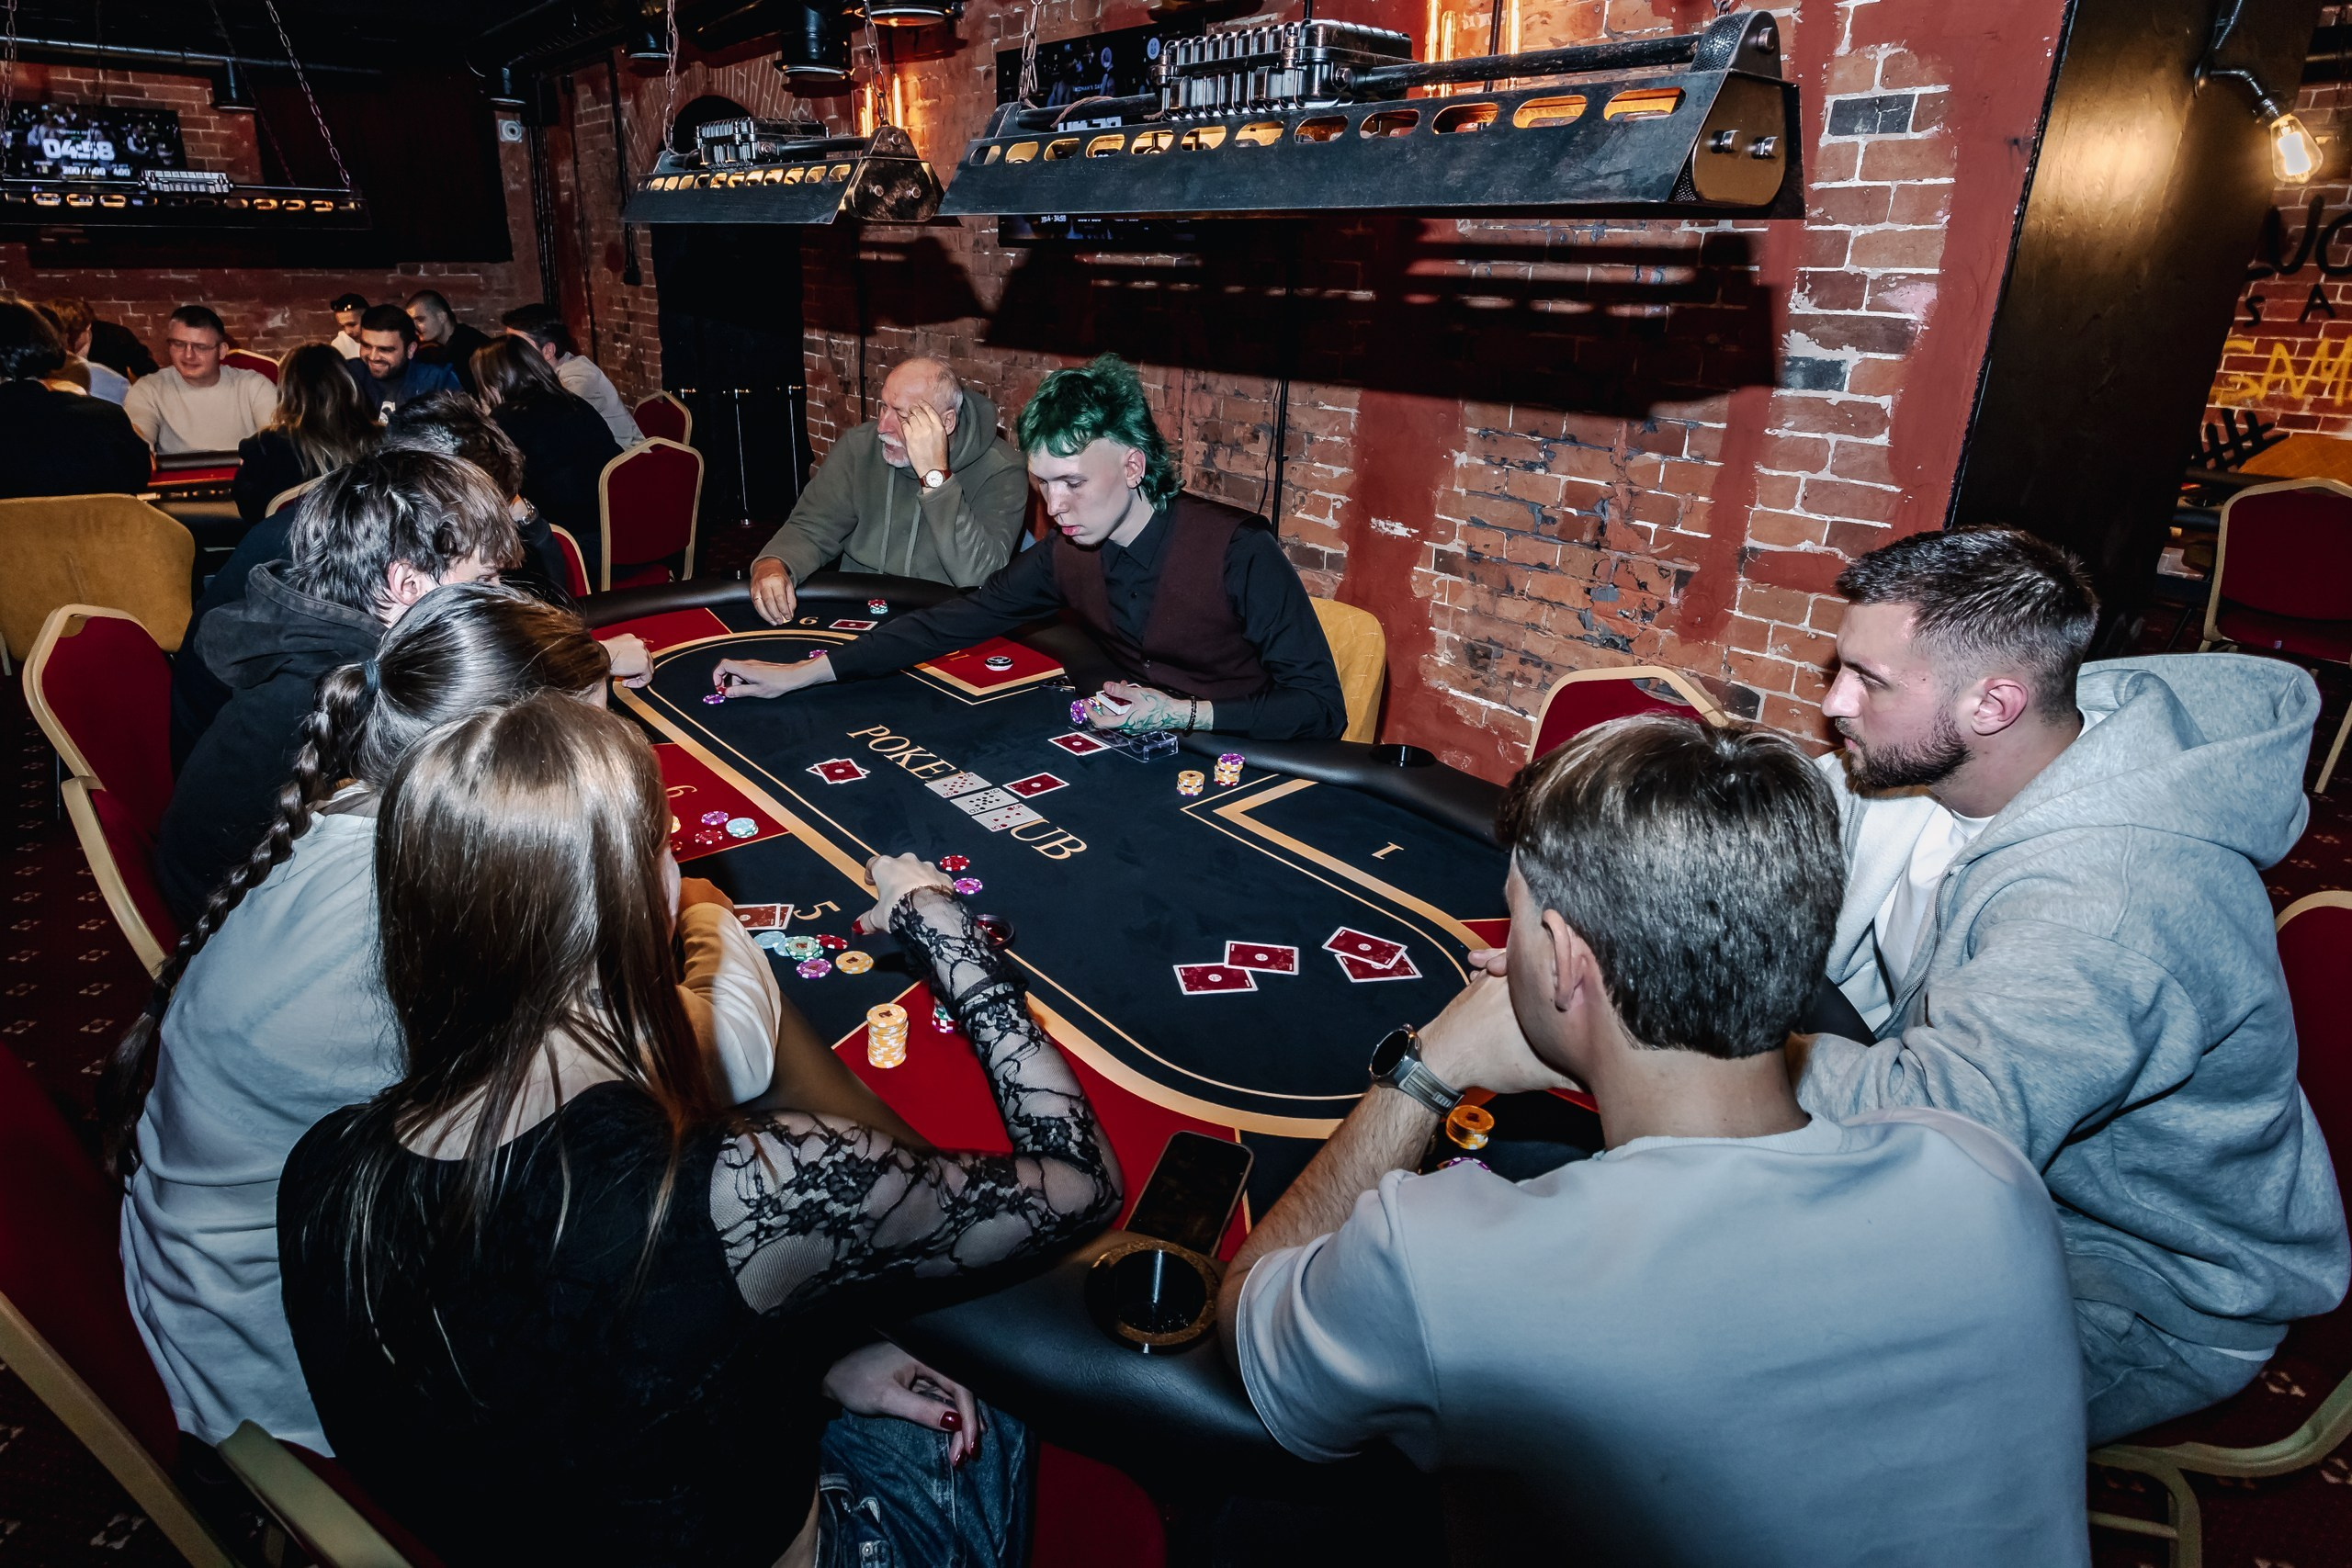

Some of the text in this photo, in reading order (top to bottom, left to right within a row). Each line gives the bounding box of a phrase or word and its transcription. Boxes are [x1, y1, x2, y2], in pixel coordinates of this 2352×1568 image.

[846, 724, 966, 783] POKE
[1011, 818, 1088, 860] UB
[793, 900, 842, 920] 5
